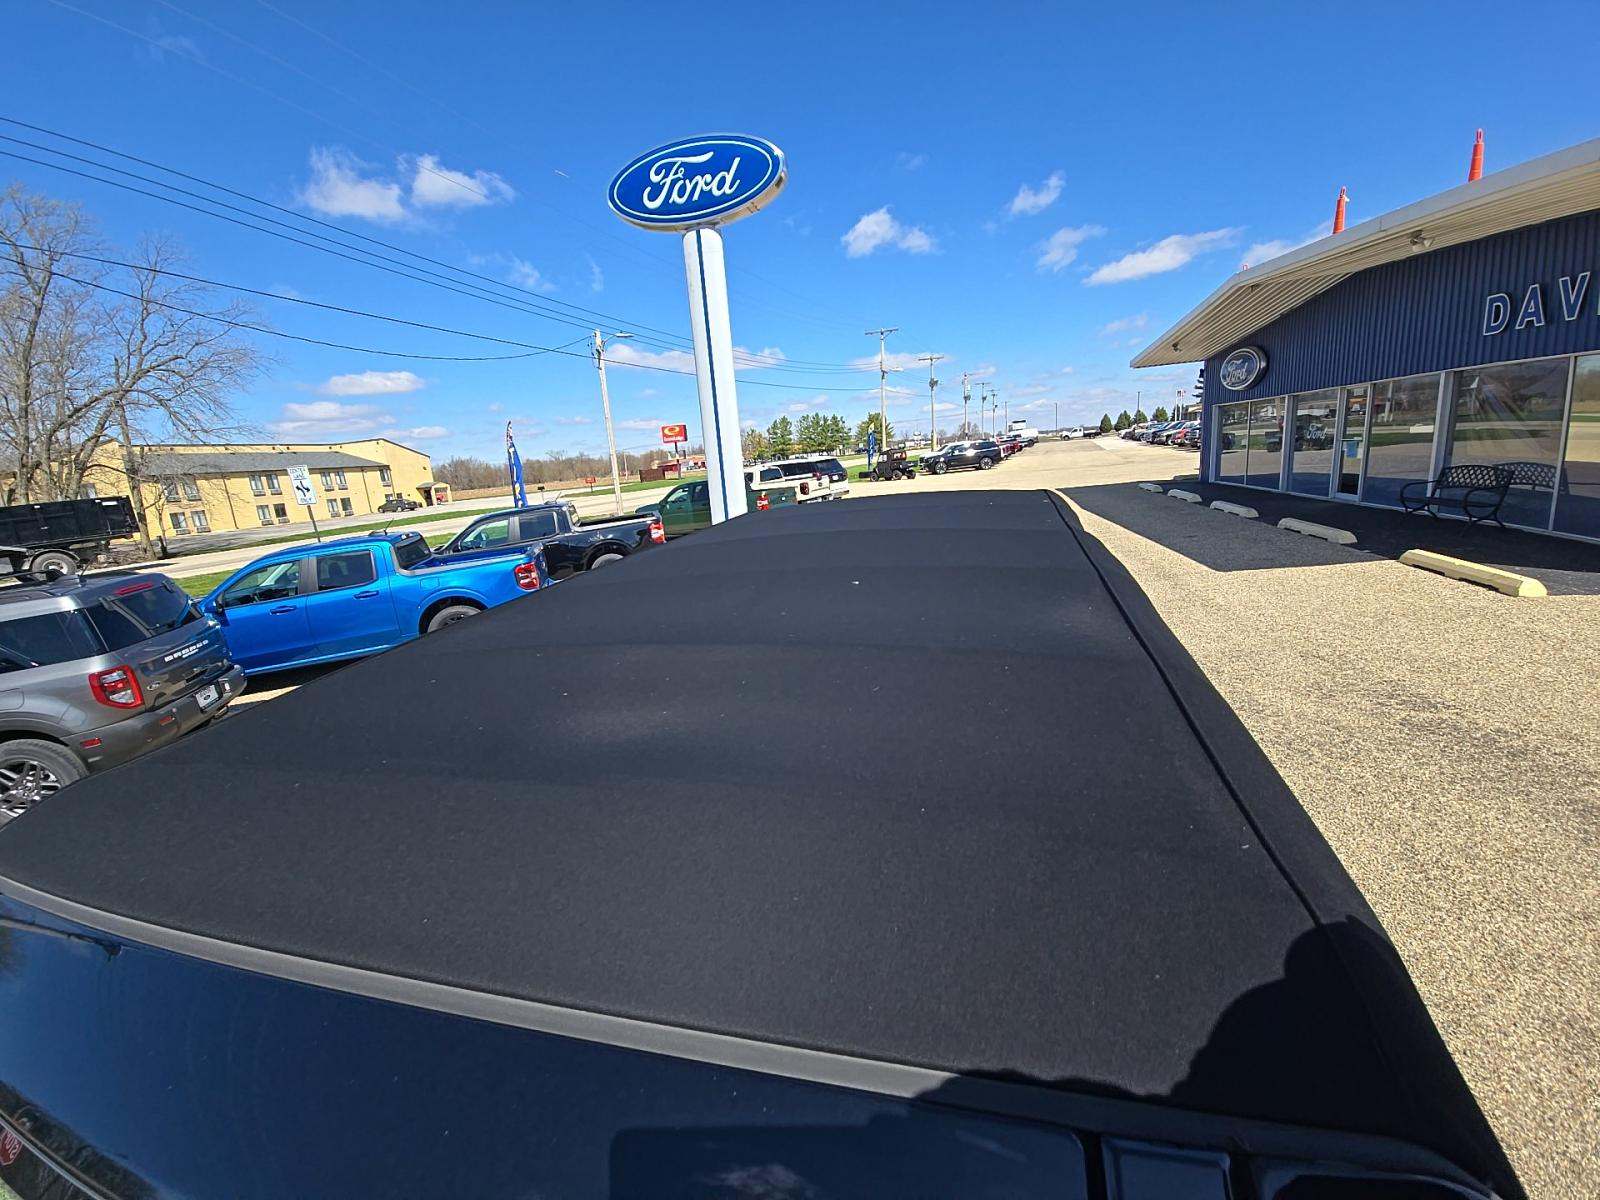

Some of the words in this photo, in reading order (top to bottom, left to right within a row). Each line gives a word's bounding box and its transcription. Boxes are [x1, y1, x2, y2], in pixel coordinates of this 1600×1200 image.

[643, 151, 741, 209] Ford
[1483, 271, 1600, 336] DAV
[1225, 358, 1248, 385] Ford
[1306, 423, 1328, 440] Ford
